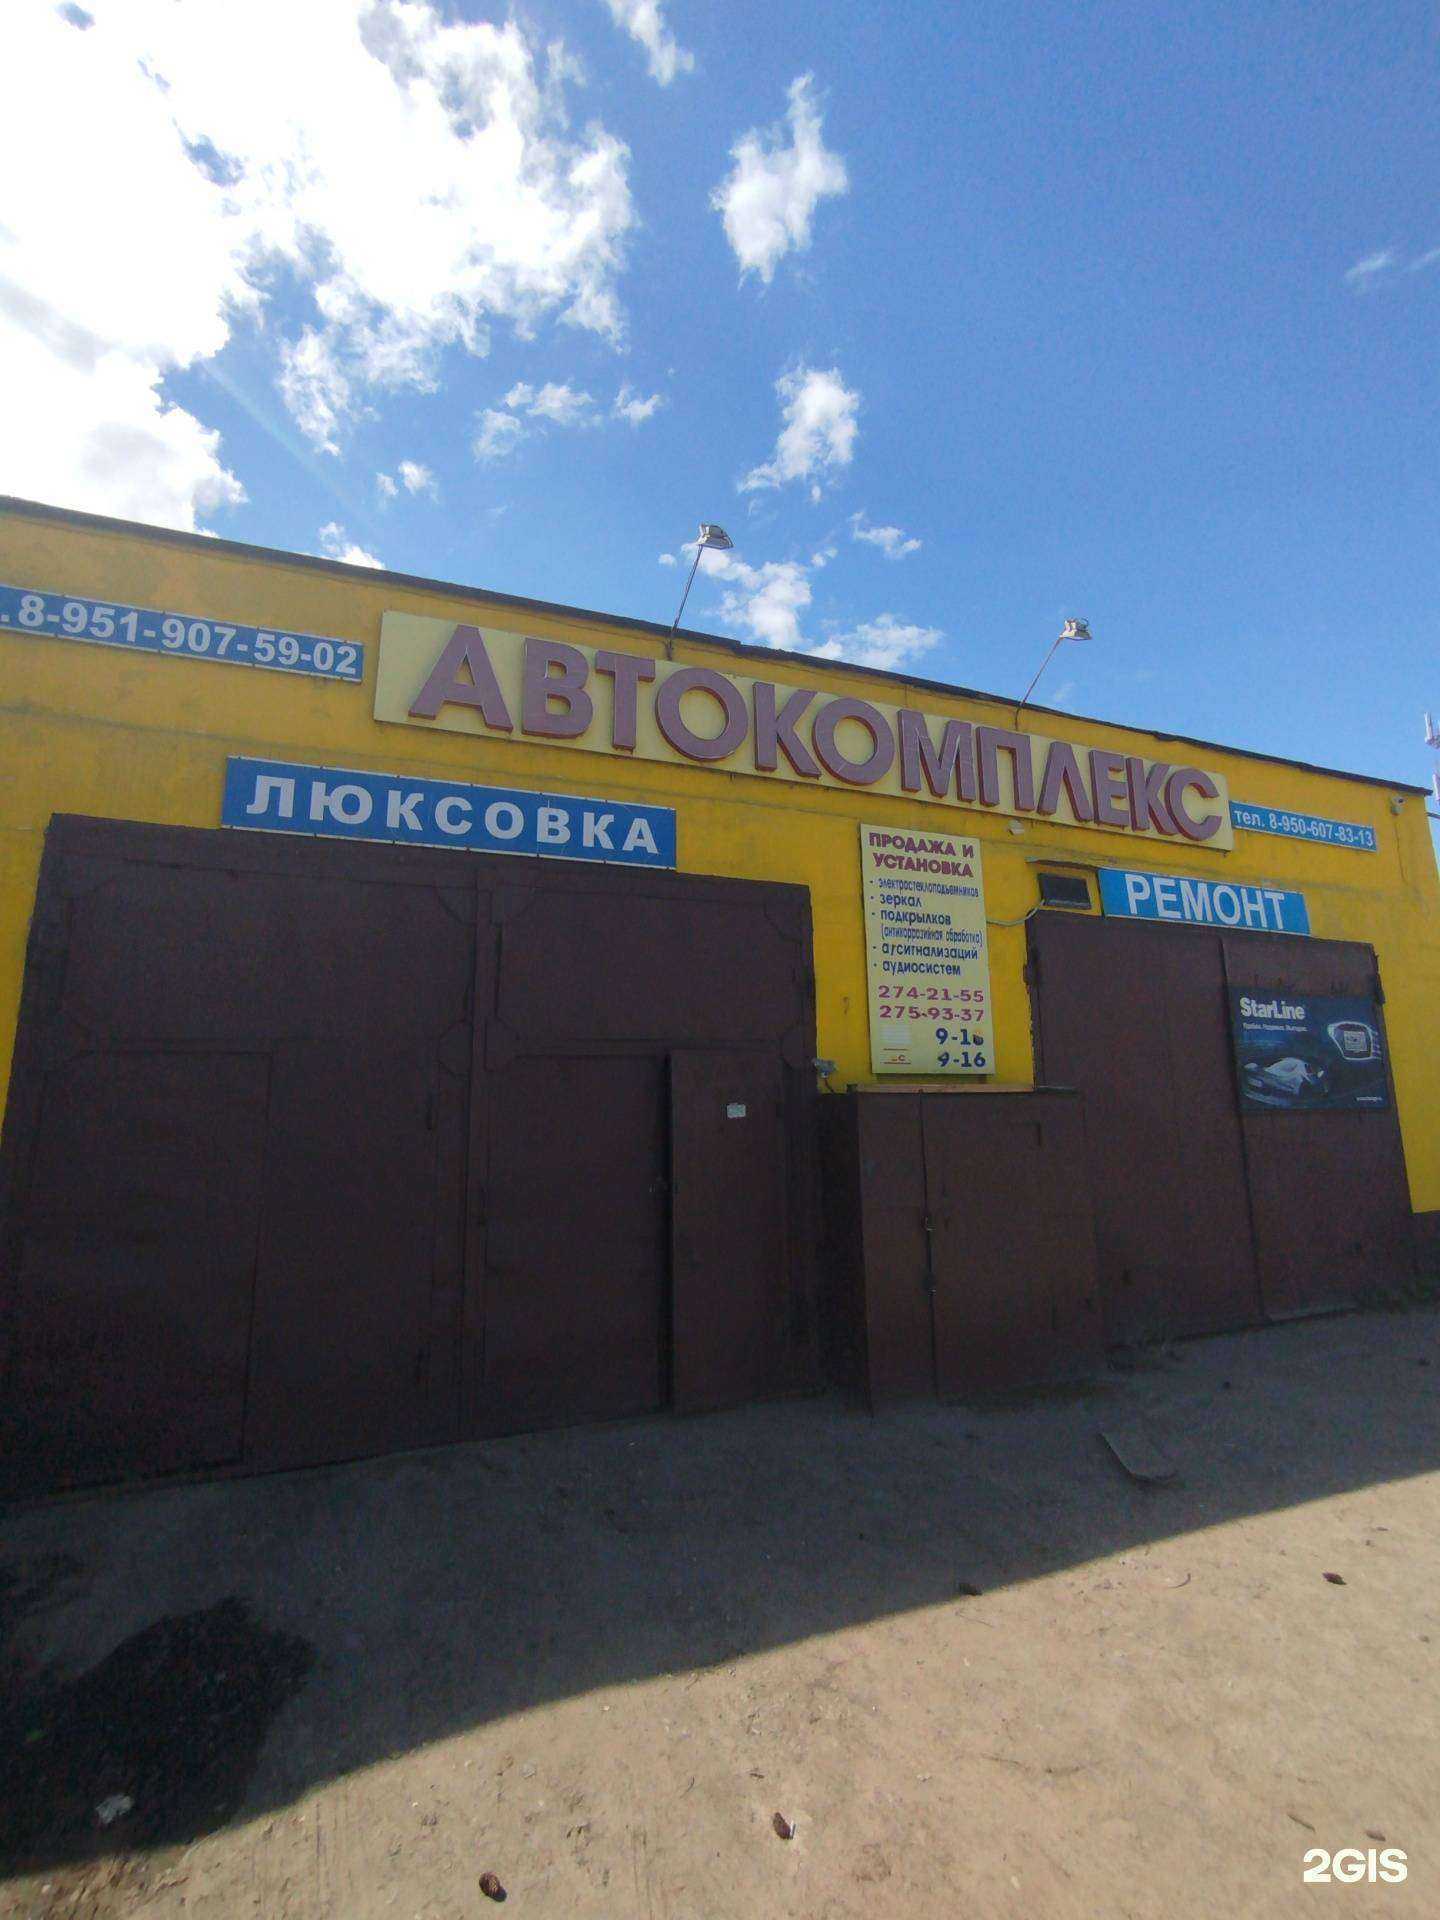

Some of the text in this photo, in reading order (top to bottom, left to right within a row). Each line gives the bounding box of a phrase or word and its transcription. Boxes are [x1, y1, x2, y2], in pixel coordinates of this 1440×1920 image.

[17, 594, 358, 675] 8-951-907-59-02
[408, 624, 1221, 842] АВТОКОМПЛЕКС
[246, 774, 660, 855] ЛЮКСОВКА
[1269, 812, 1374, 847] 8-950-607-83-13
[869, 832, 974, 858] ПРОДАЖА И
[872, 852, 974, 878] УСТАНОВКА
[880, 893, 922, 908] зеркал
[1124, 873, 1285, 930] РЕМОНТ
[880, 909, 952, 926] подкрылков
[882, 960, 960, 976] аудиосистем
[878, 985, 984, 1003] 274-21-55
[880, 1005, 985, 1022] 275-93-37
[1239, 997, 1306, 1020] StarLine
[937, 1051, 986, 1068] 9-16
